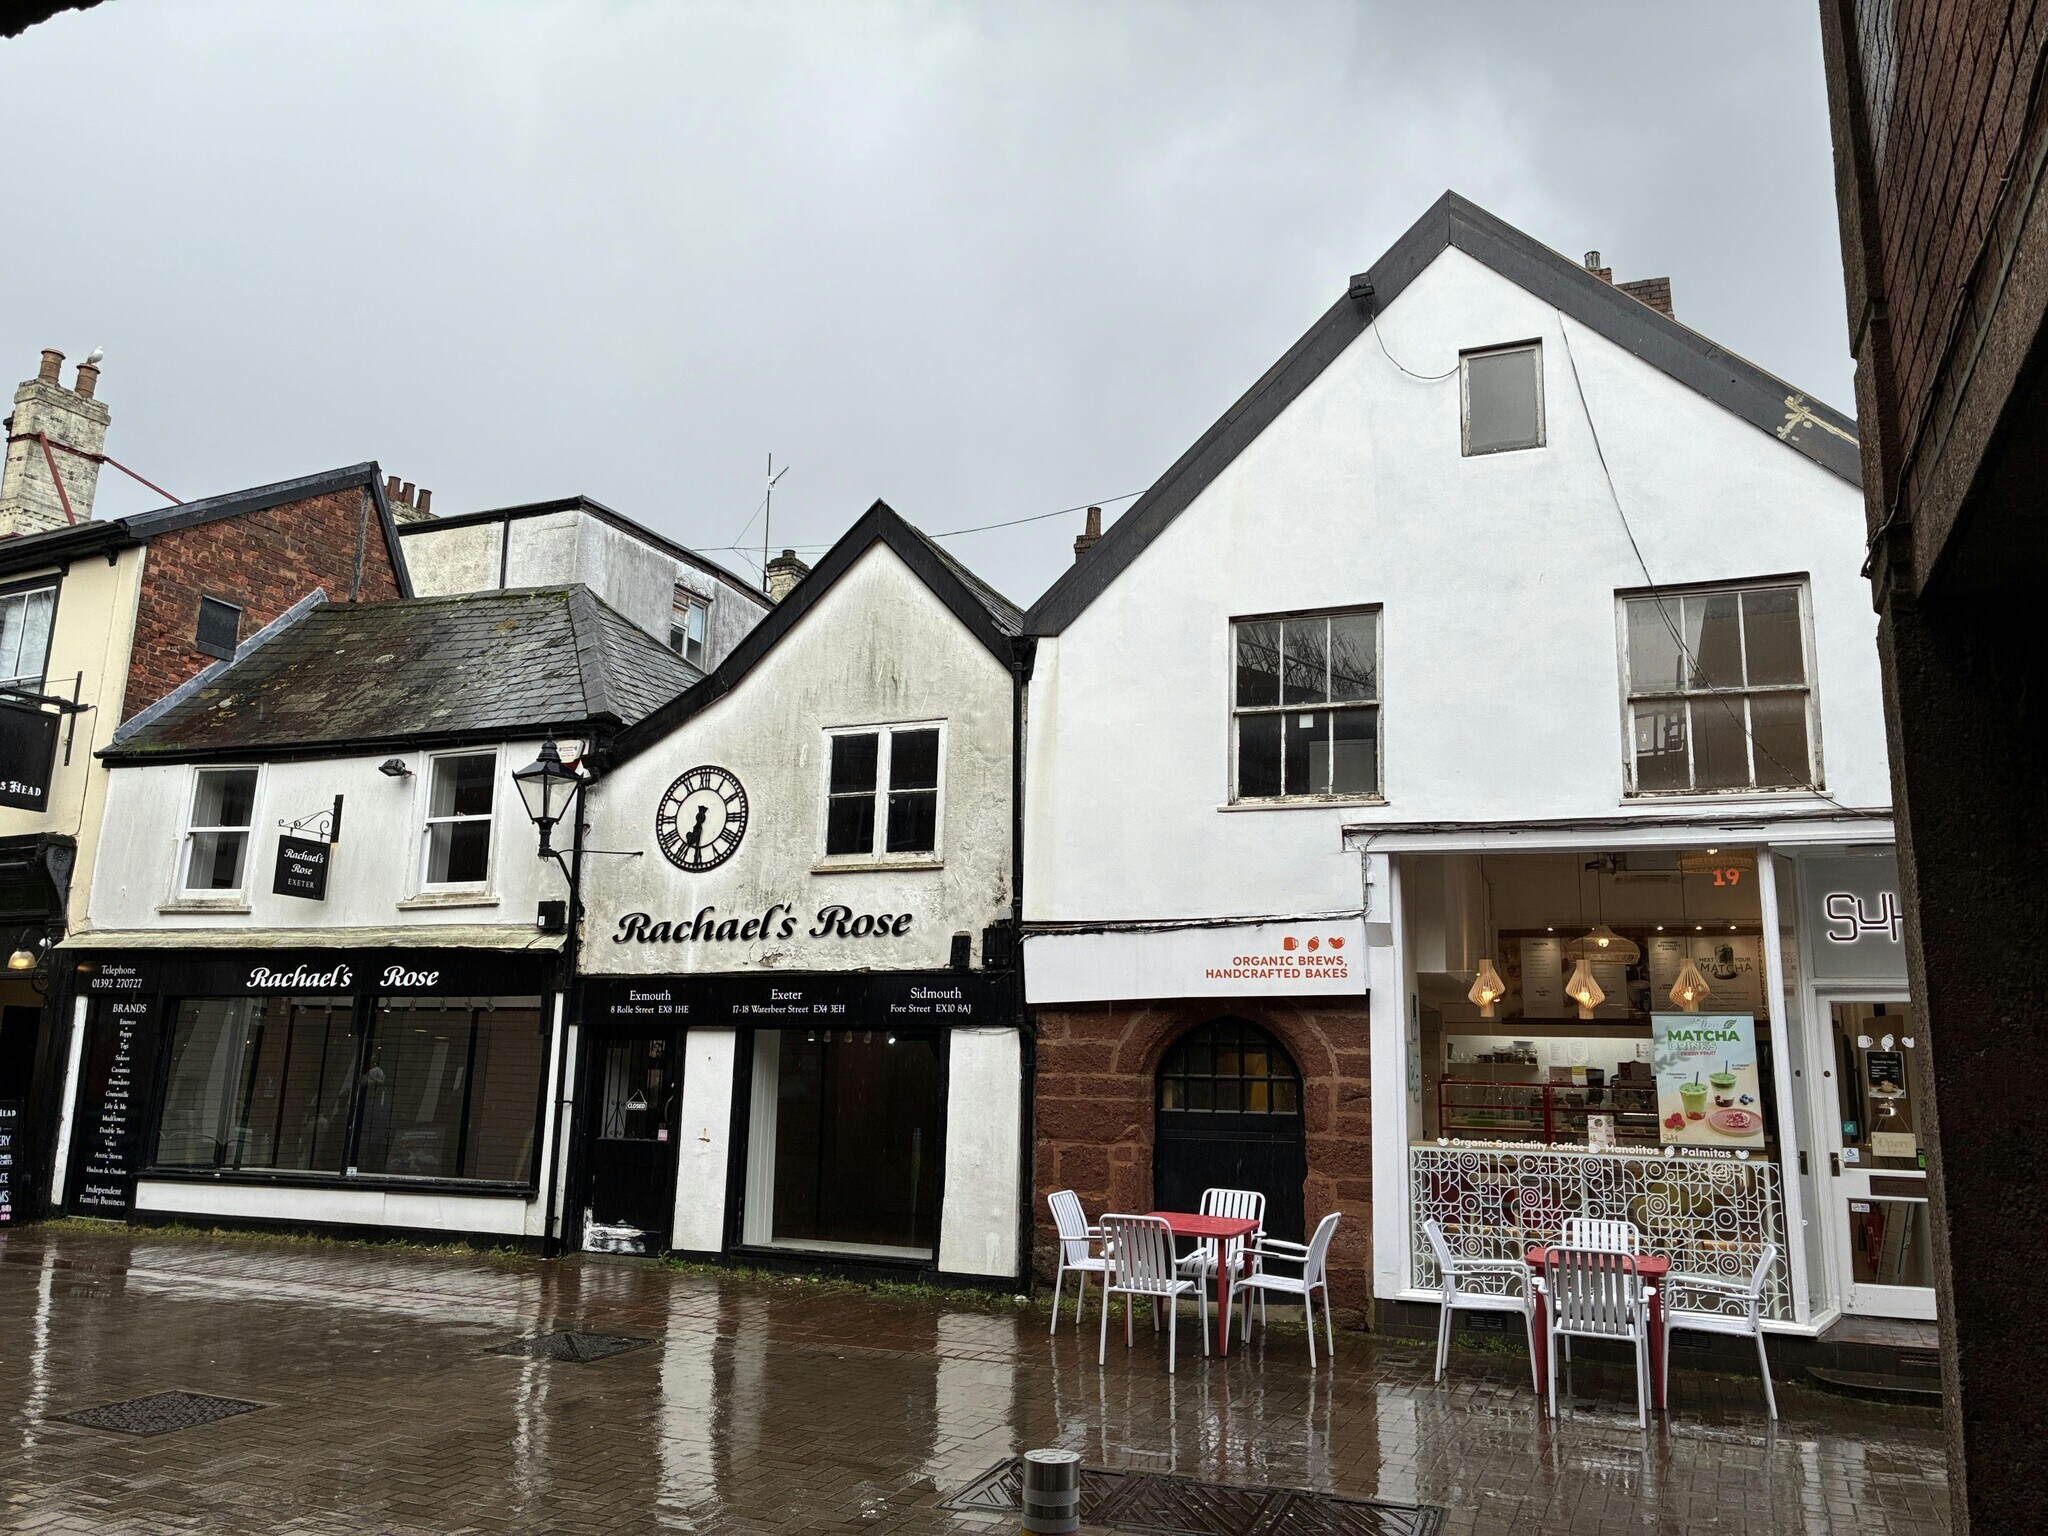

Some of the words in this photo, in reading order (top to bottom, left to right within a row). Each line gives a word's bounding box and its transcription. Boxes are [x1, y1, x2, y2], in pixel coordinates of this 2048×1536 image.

[0, 781, 6, 790] S
[10, 780, 42, 797] HEAD
[284, 848, 325, 864] Rachael's
[291, 863, 313, 875] Rose
[1713, 868, 1741, 887] 19
[287, 878, 315, 889] EXETER
[612, 903, 797, 944] Rachael's
[808, 904, 913, 938] Rose
[1232, 956, 1294, 966] ORGANIC
[1298, 955, 1348, 968] BREWS,
[1700, 962, 1753, 972] MATCHA
[102, 965, 136, 976] Telephone
[246, 964, 353, 988] Rachael's
[379, 965, 440, 987] Rose
[1205, 968, 1301, 979] HANDCRAFTED
[1305, 968, 1348, 979] BAKES
[92, 978, 113, 988] 01392
[116, 978, 142, 989] 270727
[629, 990, 672, 1001] Exmouth
[771, 988, 802, 1000] Exeter
[910, 987, 962, 999] Sidmouth
[112, 1003, 147, 1014] BRANDS
[610, 1005, 615, 1014] 8
[617, 1005, 634, 1014] Rolle
[634, 1005, 655, 1014] Street
[658, 1005, 673, 1014] EX8
[732, 1005, 750, 1014] 17-18
[751, 1005, 786, 1014] Waterbeer
[787, 1004, 809, 1014] Street
[813, 1004, 828, 1014] EX4
[829, 1004, 846, 1014] 3EH
[890, 1004, 907, 1013] Fore
[908, 1004, 931, 1013] Street
[935, 1004, 956, 1014] EX10
[957, 1004, 972, 1015] 8AJ
[1667, 1030, 1741, 1041] MATCHA
[1668, 1041, 1718, 1051] DRINKS
[1452, 1137, 1493, 1149] Organic
[1495, 1139, 1548, 1151] Speciality
[1550, 1142, 1585, 1152] Coffee
[1605, 1145, 1660, 1155] Manolitos
[1681, 1147, 1732, 1158] Palmitas
[85, 1184, 122, 1196] Independent
[79, 1194, 100, 1207] Family
[100, 1196, 126, 1207] Business
